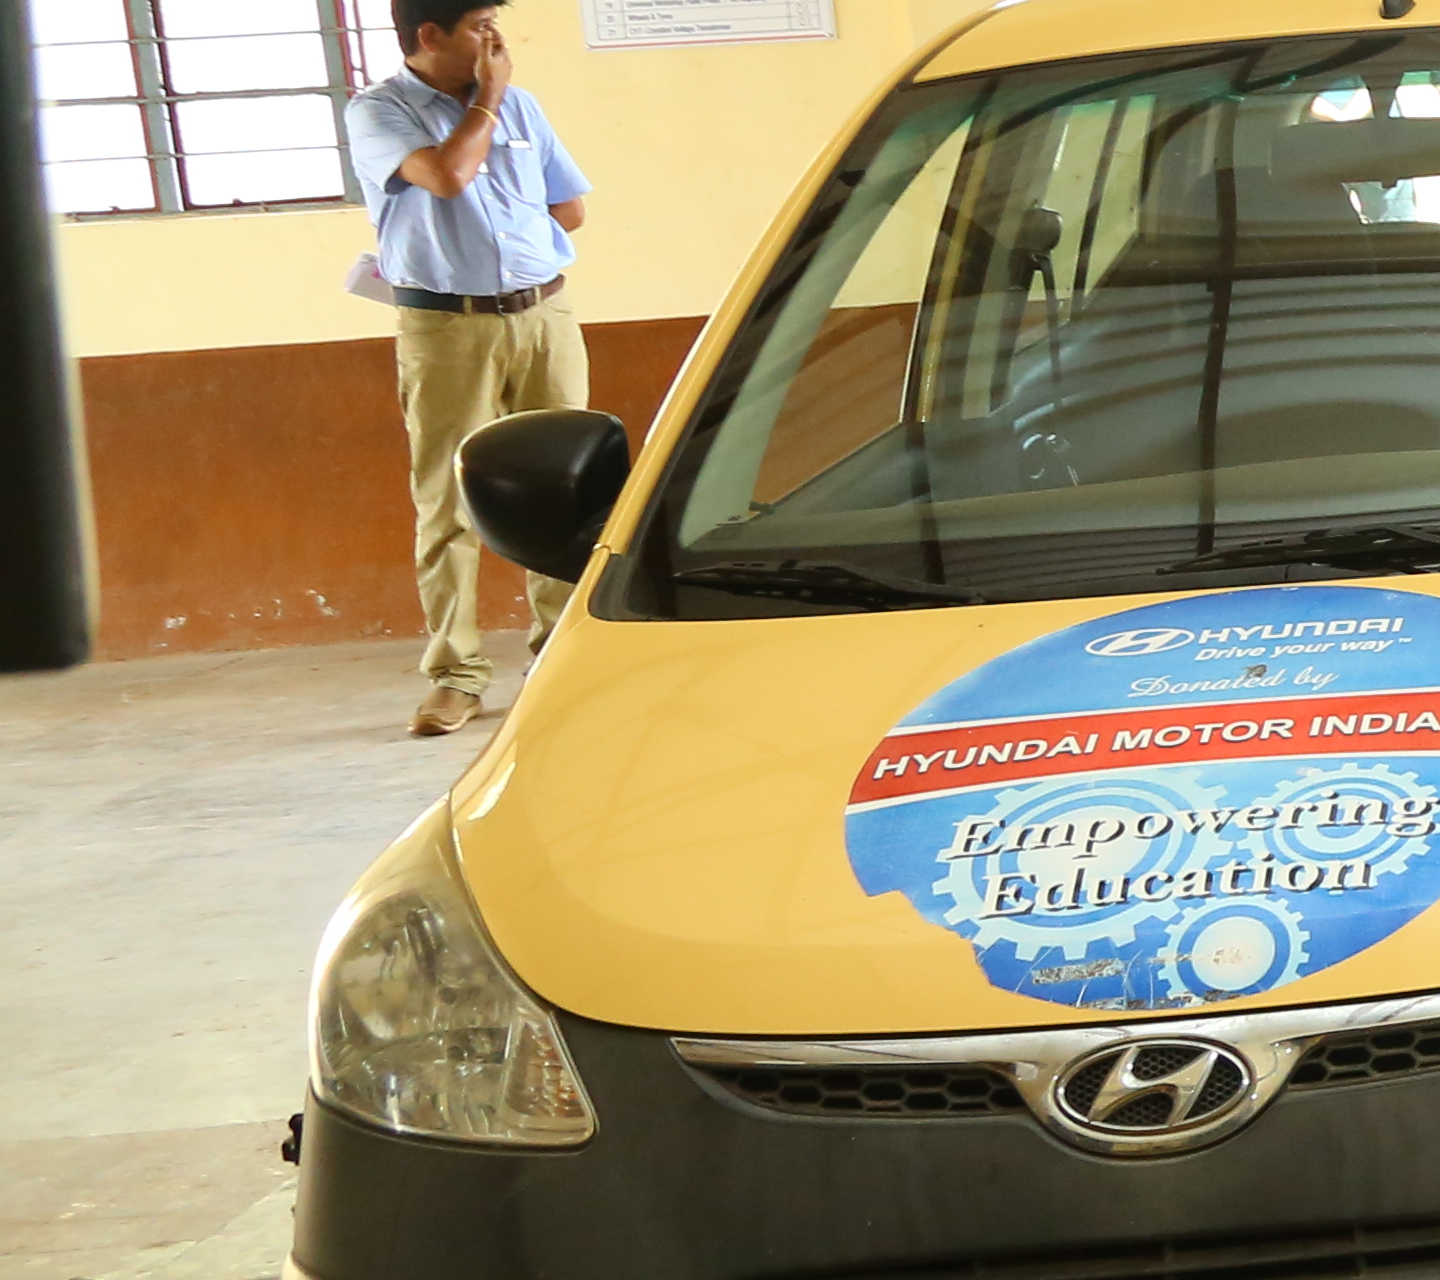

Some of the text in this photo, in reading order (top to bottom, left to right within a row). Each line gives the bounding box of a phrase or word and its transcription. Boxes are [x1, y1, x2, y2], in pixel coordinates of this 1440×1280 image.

[1197, 617, 1405, 645] HYUNDAI
[1194, 645, 1266, 662] Drive
[1270, 641, 1333, 659] your
[1339, 638, 1394, 653] way
[1128, 665, 1340, 699] Donated by
[872, 732, 1100, 780] HYUNDAI
[1111, 718, 1294, 752] MOTOR
[977, 852, 1374, 920] Education
